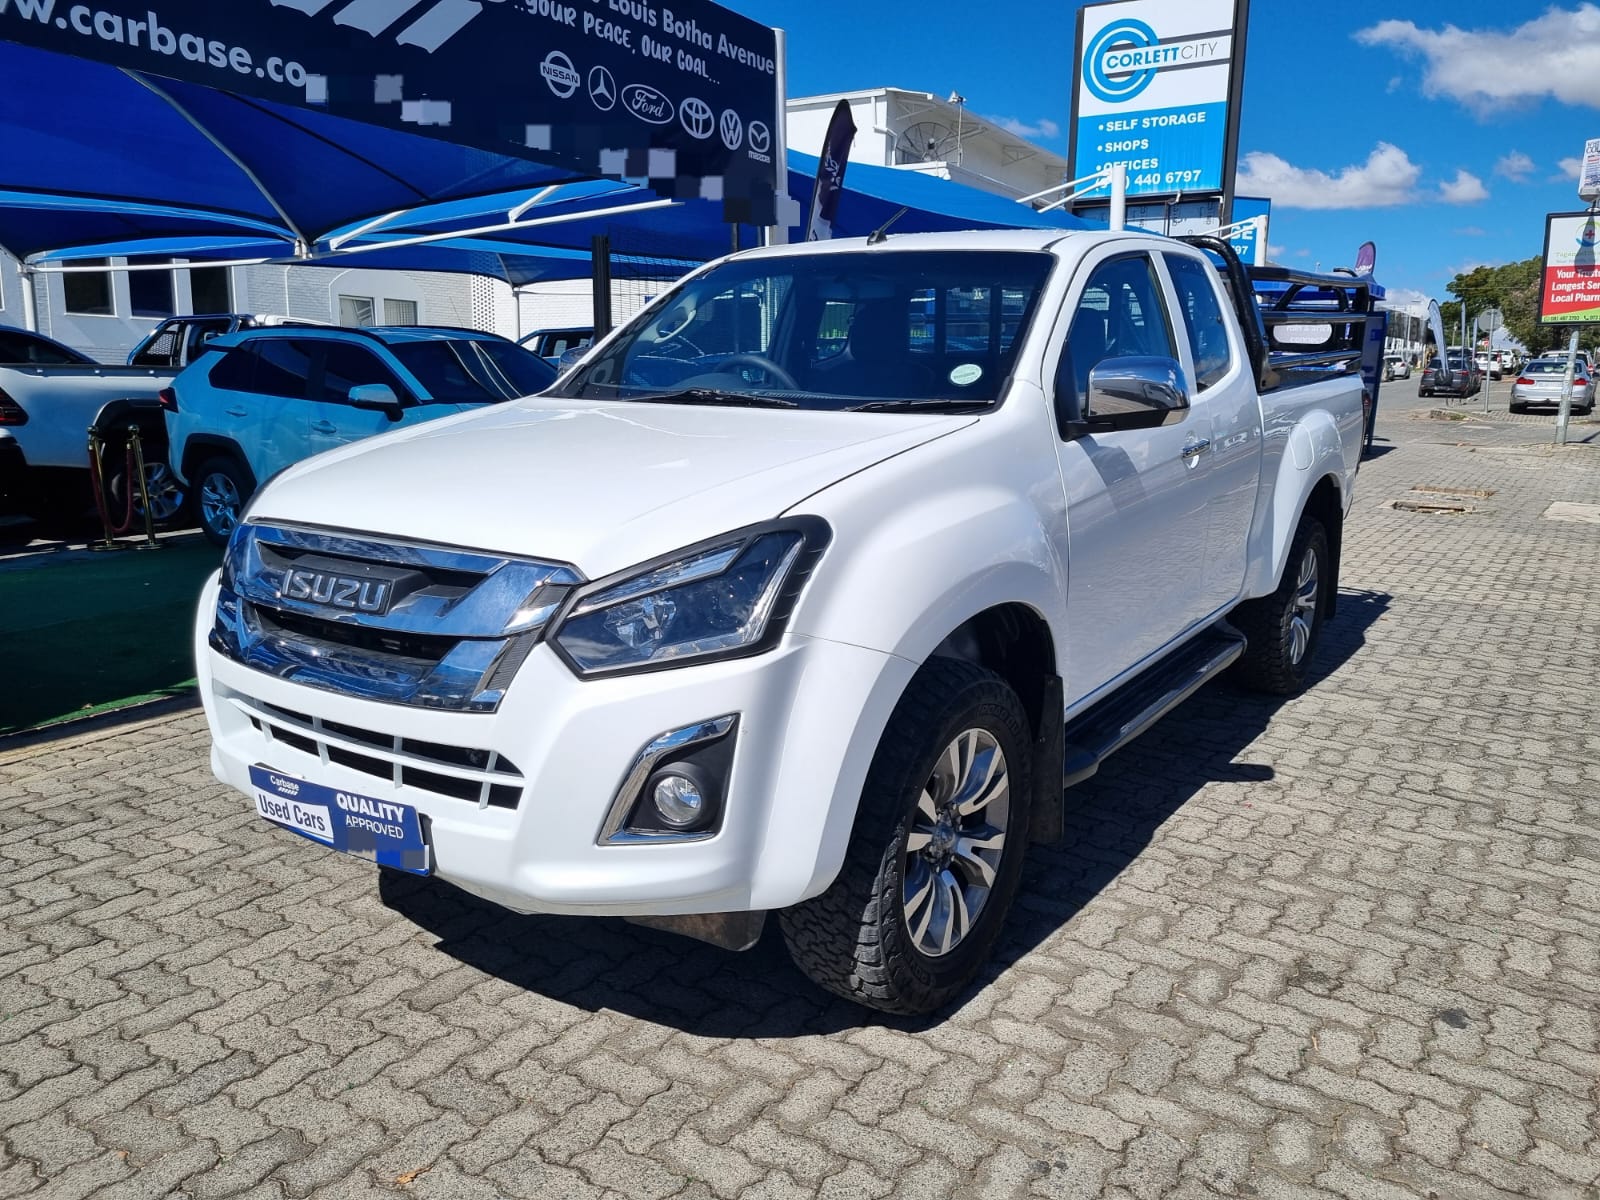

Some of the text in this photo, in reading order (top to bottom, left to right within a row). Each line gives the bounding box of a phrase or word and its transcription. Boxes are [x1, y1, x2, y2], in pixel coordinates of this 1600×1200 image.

[0, 0, 306, 87] w.carbase.co
[641, 34, 672, 63] OUR
[663, 8, 712, 50] Botha
[717, 33, 775, 75] Avenue
[542, 63, 578, 83] NISSAN
[632, 89, 664, 117] Ford
[1106, 111, 1206, 132] SELF STORAGE
[1104, 139, 1149, 153] SHOPS
[1134, 173, 1161, 186] 440
[1165, 170, 1202, 184] 6797
[1556, 269, 1576, 279] Your
[1551, 281, 1585, 292] Longest
[1551, 293, 1574, 303] Local
[281, 568, 386, 610] ISUZU
[269, 775, 300, 790] Carbase
[257, 793, 326, 833] Used Cars
[336, 792, 405, 823] QUALITY
[345, 815, 404, 840] APPROVED
